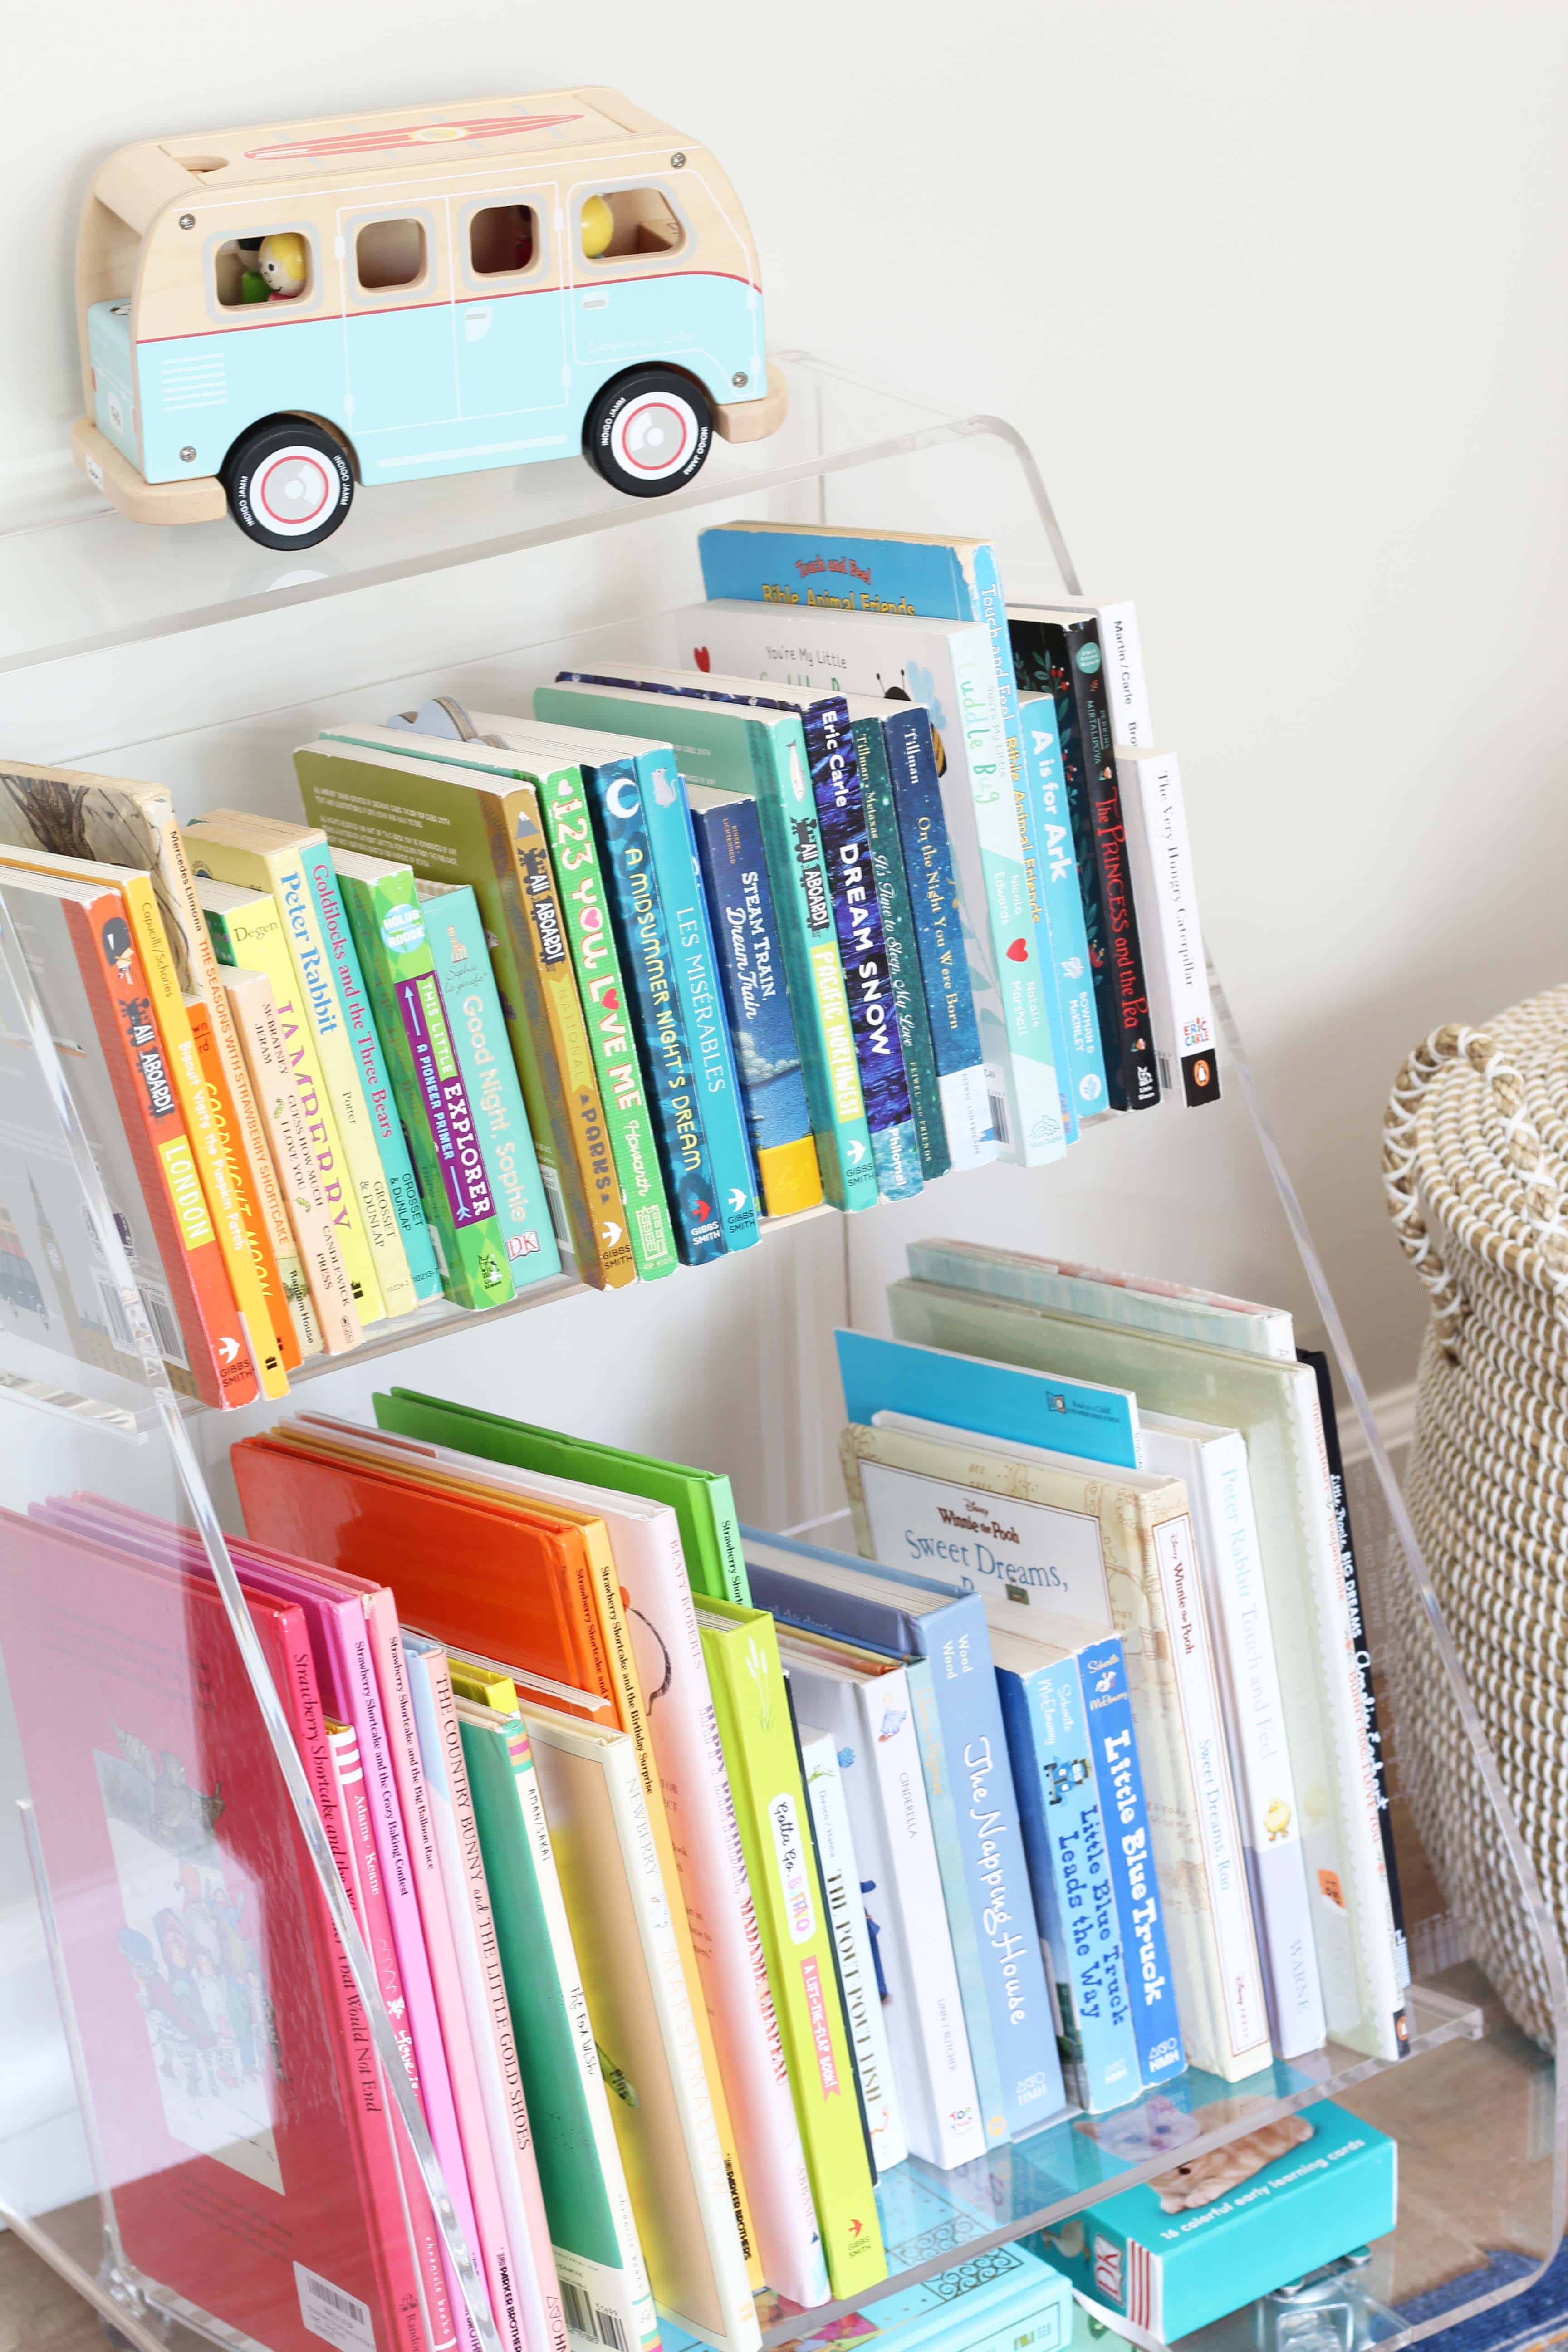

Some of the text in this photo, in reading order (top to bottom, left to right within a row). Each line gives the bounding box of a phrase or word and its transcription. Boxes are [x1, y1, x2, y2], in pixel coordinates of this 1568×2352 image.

[601, 397, 627, 446] INDIGO JAMM
[683, 426, 708, 475] INDIGO JAMM
[239, 476, 255, 527] INDIGO JAMM
[333, 455, 350, 505] INDIGO JAMM
[795, 554, 871, 585] Touch and Feel
[765, 646, 848, 670] You're My Little
[1030, 729, 1068, 883] A is for Ark
[169, 831, 189, 888] Mercedes
[822, 710, 891, 1055] Eric Carle DREAM SNOW
[904, 725, 958, 1030] Tillman On the Night You Were Born
[1156, 769, 1195, 986] The Very Hungry Caterpillar
[183, 889, 202, 932] Llimona
[233, 921, 278, 942] Degen
[804, 870, 829, 926] ABOARD!
[1096, 785, 1148, 1029] The PRINCESS and the Pea
[198, 939, 211, 964] THE
[726, 907, 760, 1020] Dream Train
[741, 871, 776, 1000] STEAM TRAIN,
[202, 964, 228, 1032] SEASONS
[281, 871, 356, 1125] Peter Rabbit Potter
[313, 864, 392, 1138] Goldilocks and the Three Bears
[625, 848, 702, 1171] A MIDSUMMER NIGHT'S DREAM
[676, 907, 725, 1093] LES MISÉRABLES
[817, 951, 843, 1019] PACIFIC
[226, 1035, 242, 1071] WITH
[828, 1024, 860, 1117] NORTHWEST
[233, 1075, 268, 1164] STRAWBERRY
[416, 1043, 455, 1160] A PIONEER PRIMER
[421, 981, 490, 1215] THIS LITTLE EXPLORER
[462, 995, 528, 1223] Good Night, Sophie
[139, 1053, 175, 1113] ABOARD!
[164, 1145, 210, 1239] LONDON
[846, 1163, 873, 1177] GIBBS
[889, 1127, 907, 1186] Philomel
[259, 1165, 290, 1246] SHORTCAKE
[373, 1181, 396, 1237] GROSSET
[402, 1172, 423, 1226] GROSSET
[848, 1173, 874, 1188] SMITH
[507, 1233, 538, 1258] DK
[690, 1221, 719, 1236] GIBBS
[692, 1230, 721, 1246] SMITH
[727, 1210, 754, 1224] GIBBS
[729, 1220, 756, 1234] SMITH
[316, 1253, 333, 1290] PRESS
[322, 1225, 350, 1308] CANDLEWICK
[602, 1245, 631, 1259] GIBBS
[604, 1256, 633, 1270] SMITH
[220, 1358, 250, 1379] GIBBS
[223, 1368, 252, 1389] SMITH
[905, 1531, 1068, 1592] Sweet Dreams,
[600, 1566, 617, 1621] Strawberry
[612, 1621, 627, 1671] Shortcake
[622, 1671, 631, 1690] and
[630, 1710, 644, 1752] Birthday
[638, 1752, 653, 1794] Surprise
[943, 1640, 957, 1679] Wood
[959, 1633, 973, 1674] Wood
[355, 1641, 408, 1897] Strawberry Shortcake and the Crazy Baking Contest
[626, 1776, 659, 1875] NEWBERRY
[899, 1772, 918, 1839] CINDERELLA
[964, 1736, 1027, 2026] The Napping House
[1103, 1729, 1166, 2005] Little Blue Truck
[435, 1672, 532, 2151] THE COUNTRY BUNNY and THE LITTLE GOLD SHOES
[1059, 1830, 1101, 2019] Leads the Way
[1080, 1805, 1128, 2026] Little Blue Truck
[827, 1869, 882, 2103] THE POUT-POUT FISH
[1289, 1940, 1312, 2014] WARNE
[726, 2170, 751, 2260] PARKER BROTHERS
[1161, 2139, 1365, 2240] 16 colorful early learning cards
[426, 2237, 449, 2336] chronicle books
